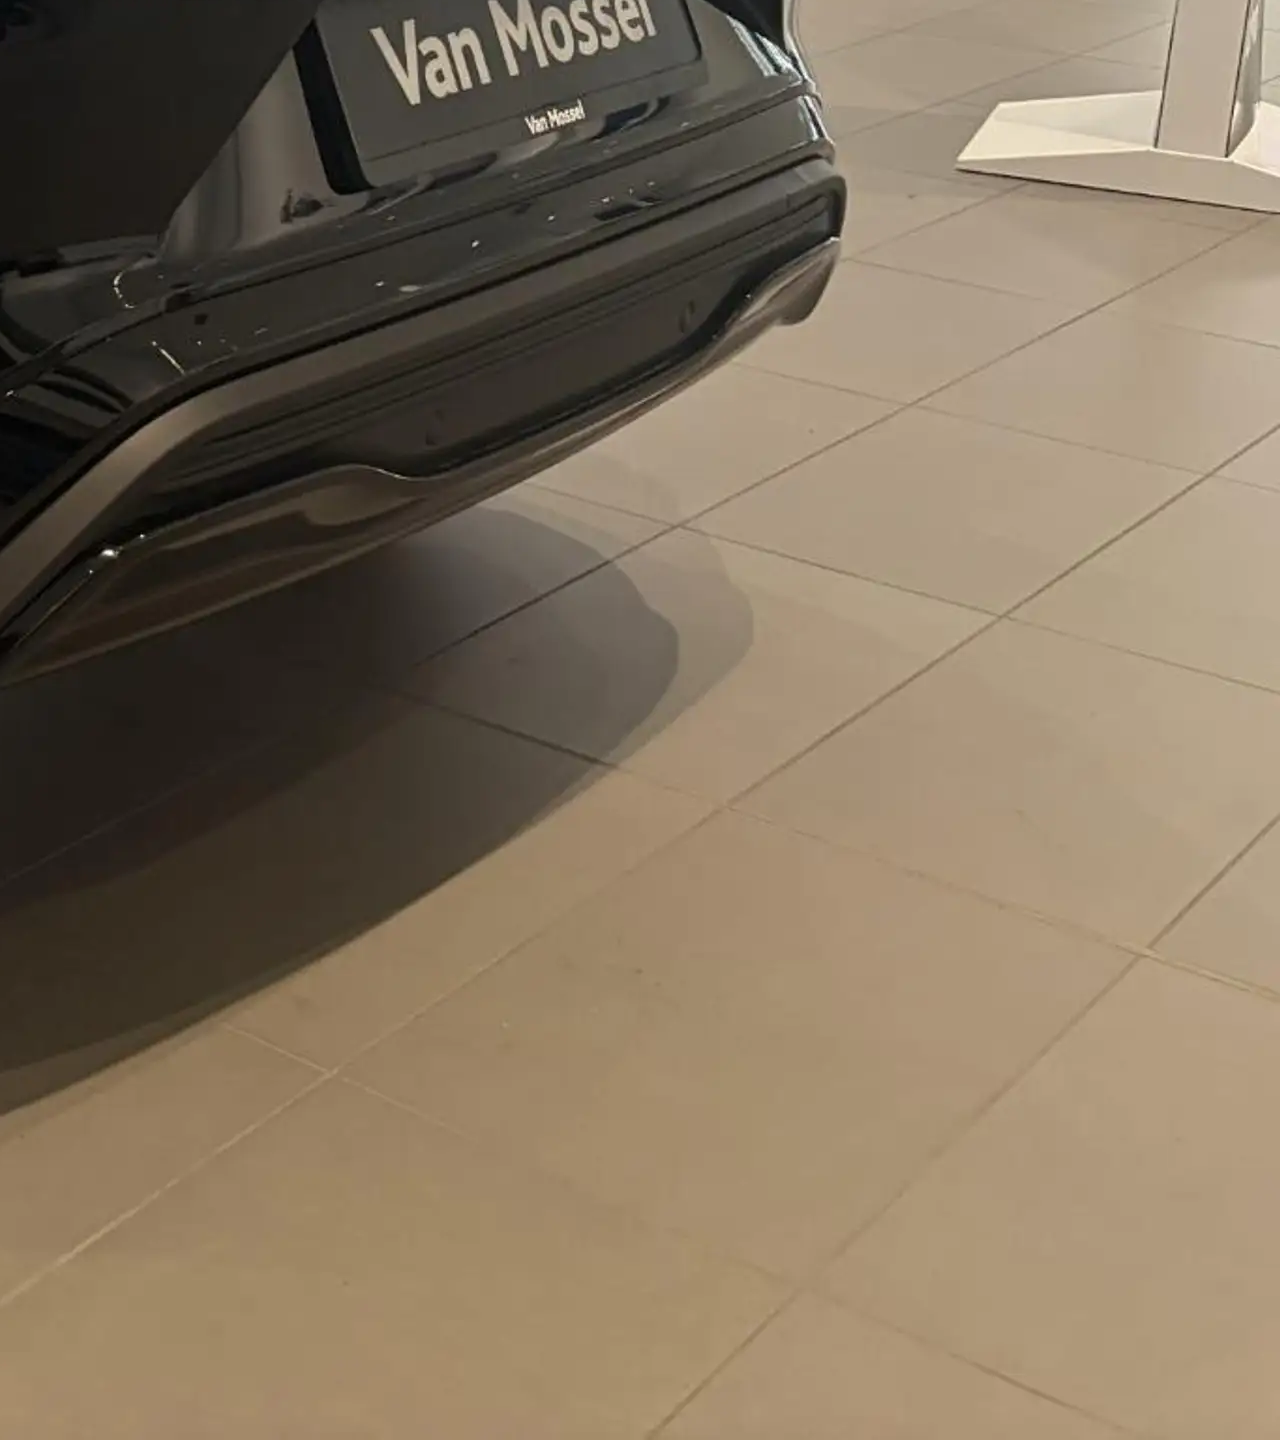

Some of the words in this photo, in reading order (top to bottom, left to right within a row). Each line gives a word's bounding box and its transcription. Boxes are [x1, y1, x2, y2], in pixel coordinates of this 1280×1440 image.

[369, 18, 492, 105] Van
[524, 114, 549, 135] Van
[546, 98, 586, 128] Mossel
